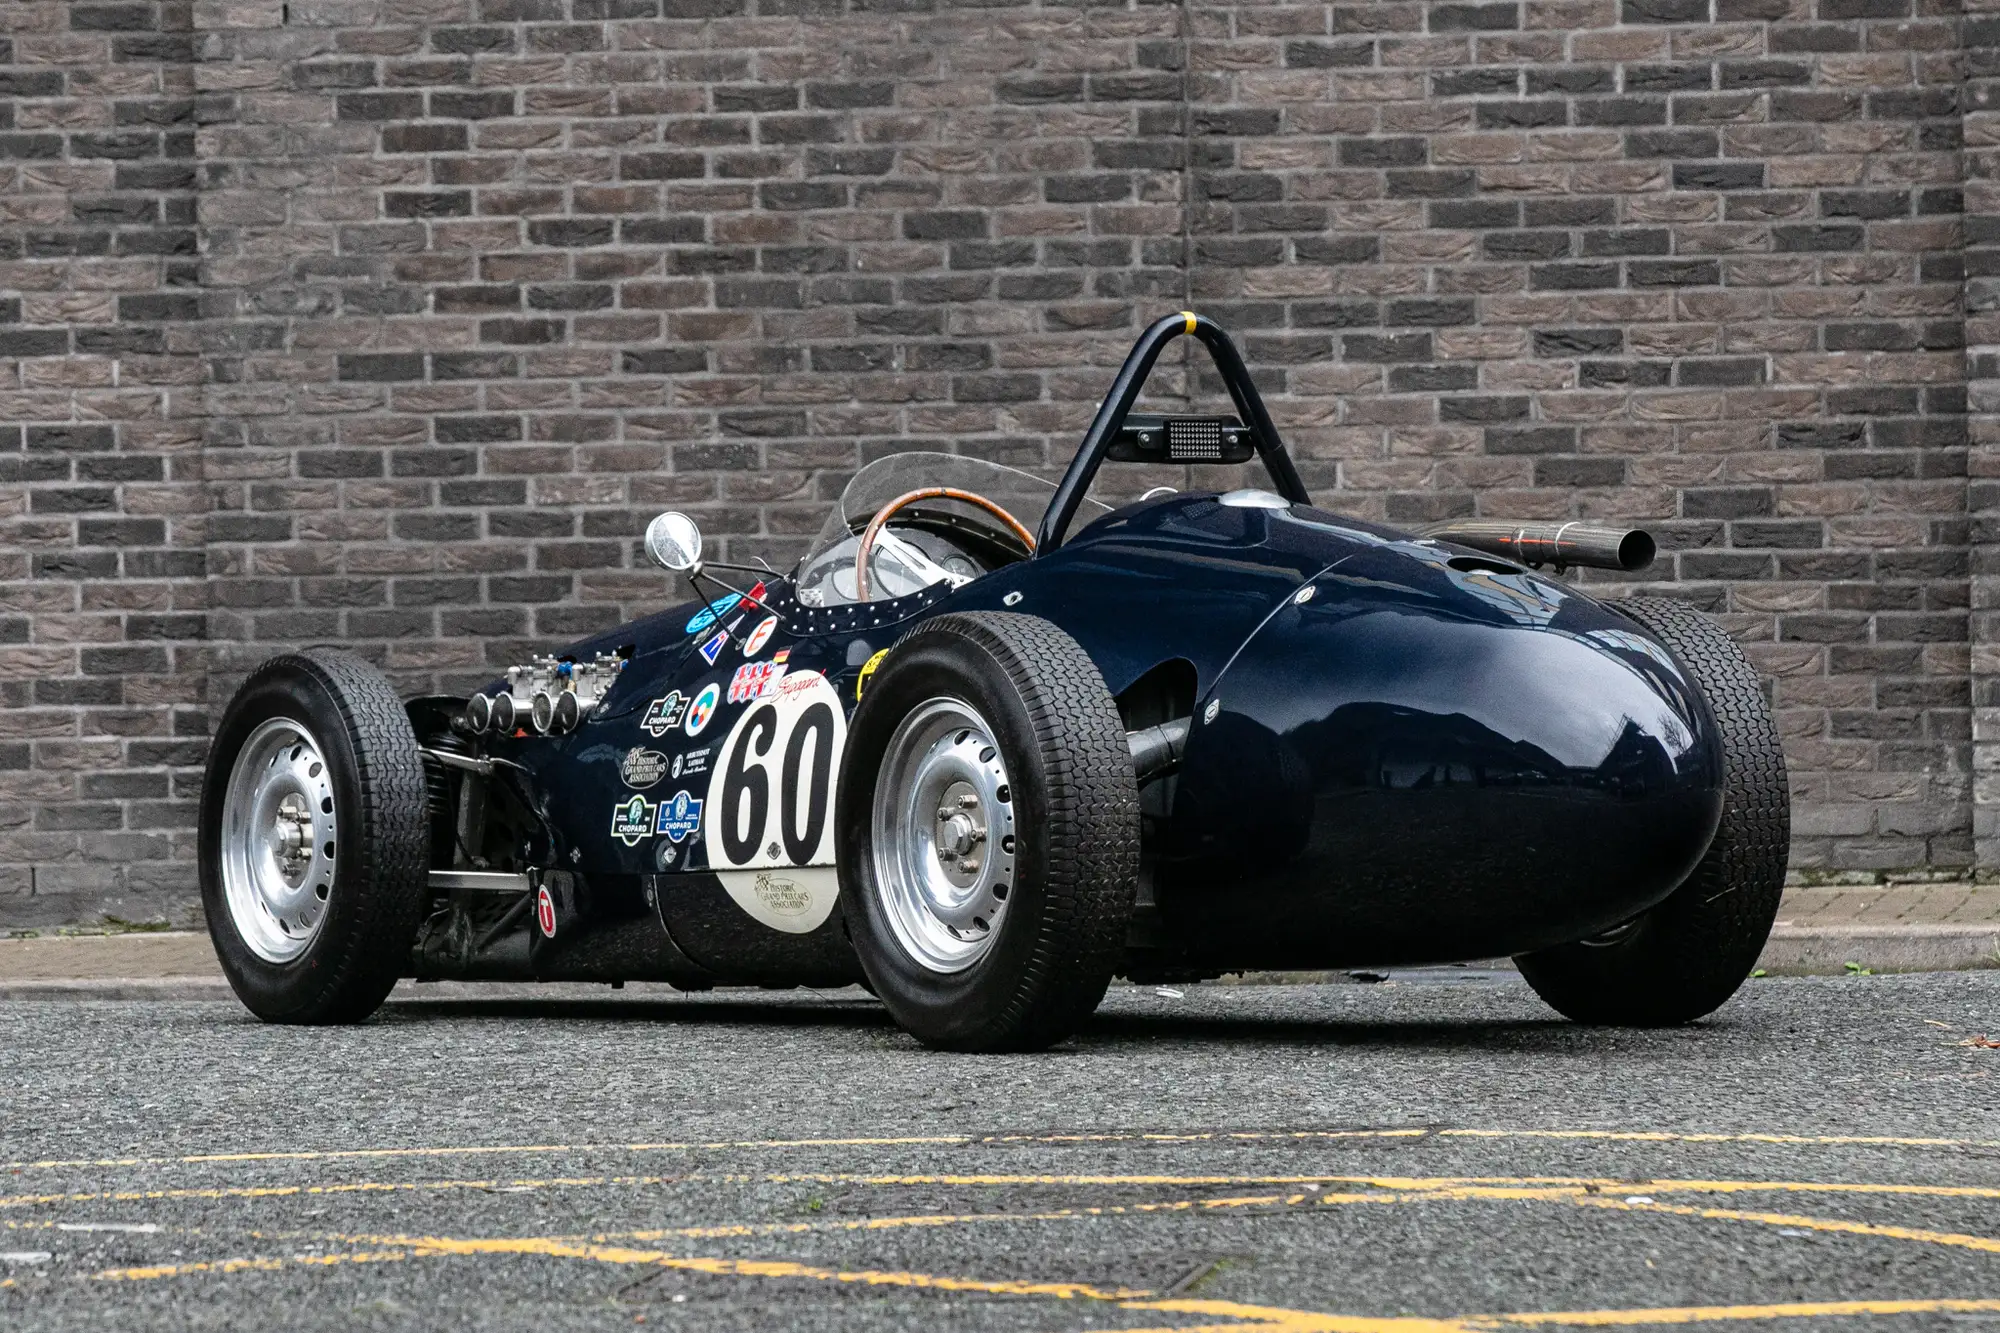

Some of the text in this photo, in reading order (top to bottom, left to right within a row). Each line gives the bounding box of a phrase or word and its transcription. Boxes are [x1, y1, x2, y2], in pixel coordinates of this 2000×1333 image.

[648, 716, 676, 725] CHOPARD
[721, 702, 834, 866] 60
[618, 824, 647, 833] CHOPARD
[665, 821, 692, 830] CHOPARD
[769, 883, 796, 892] HISTORIC
[761, 892, 781, 902] GRAND
[770, 900, 806, 909] ASSOCIATION
[540, 898, 549, 928] T
